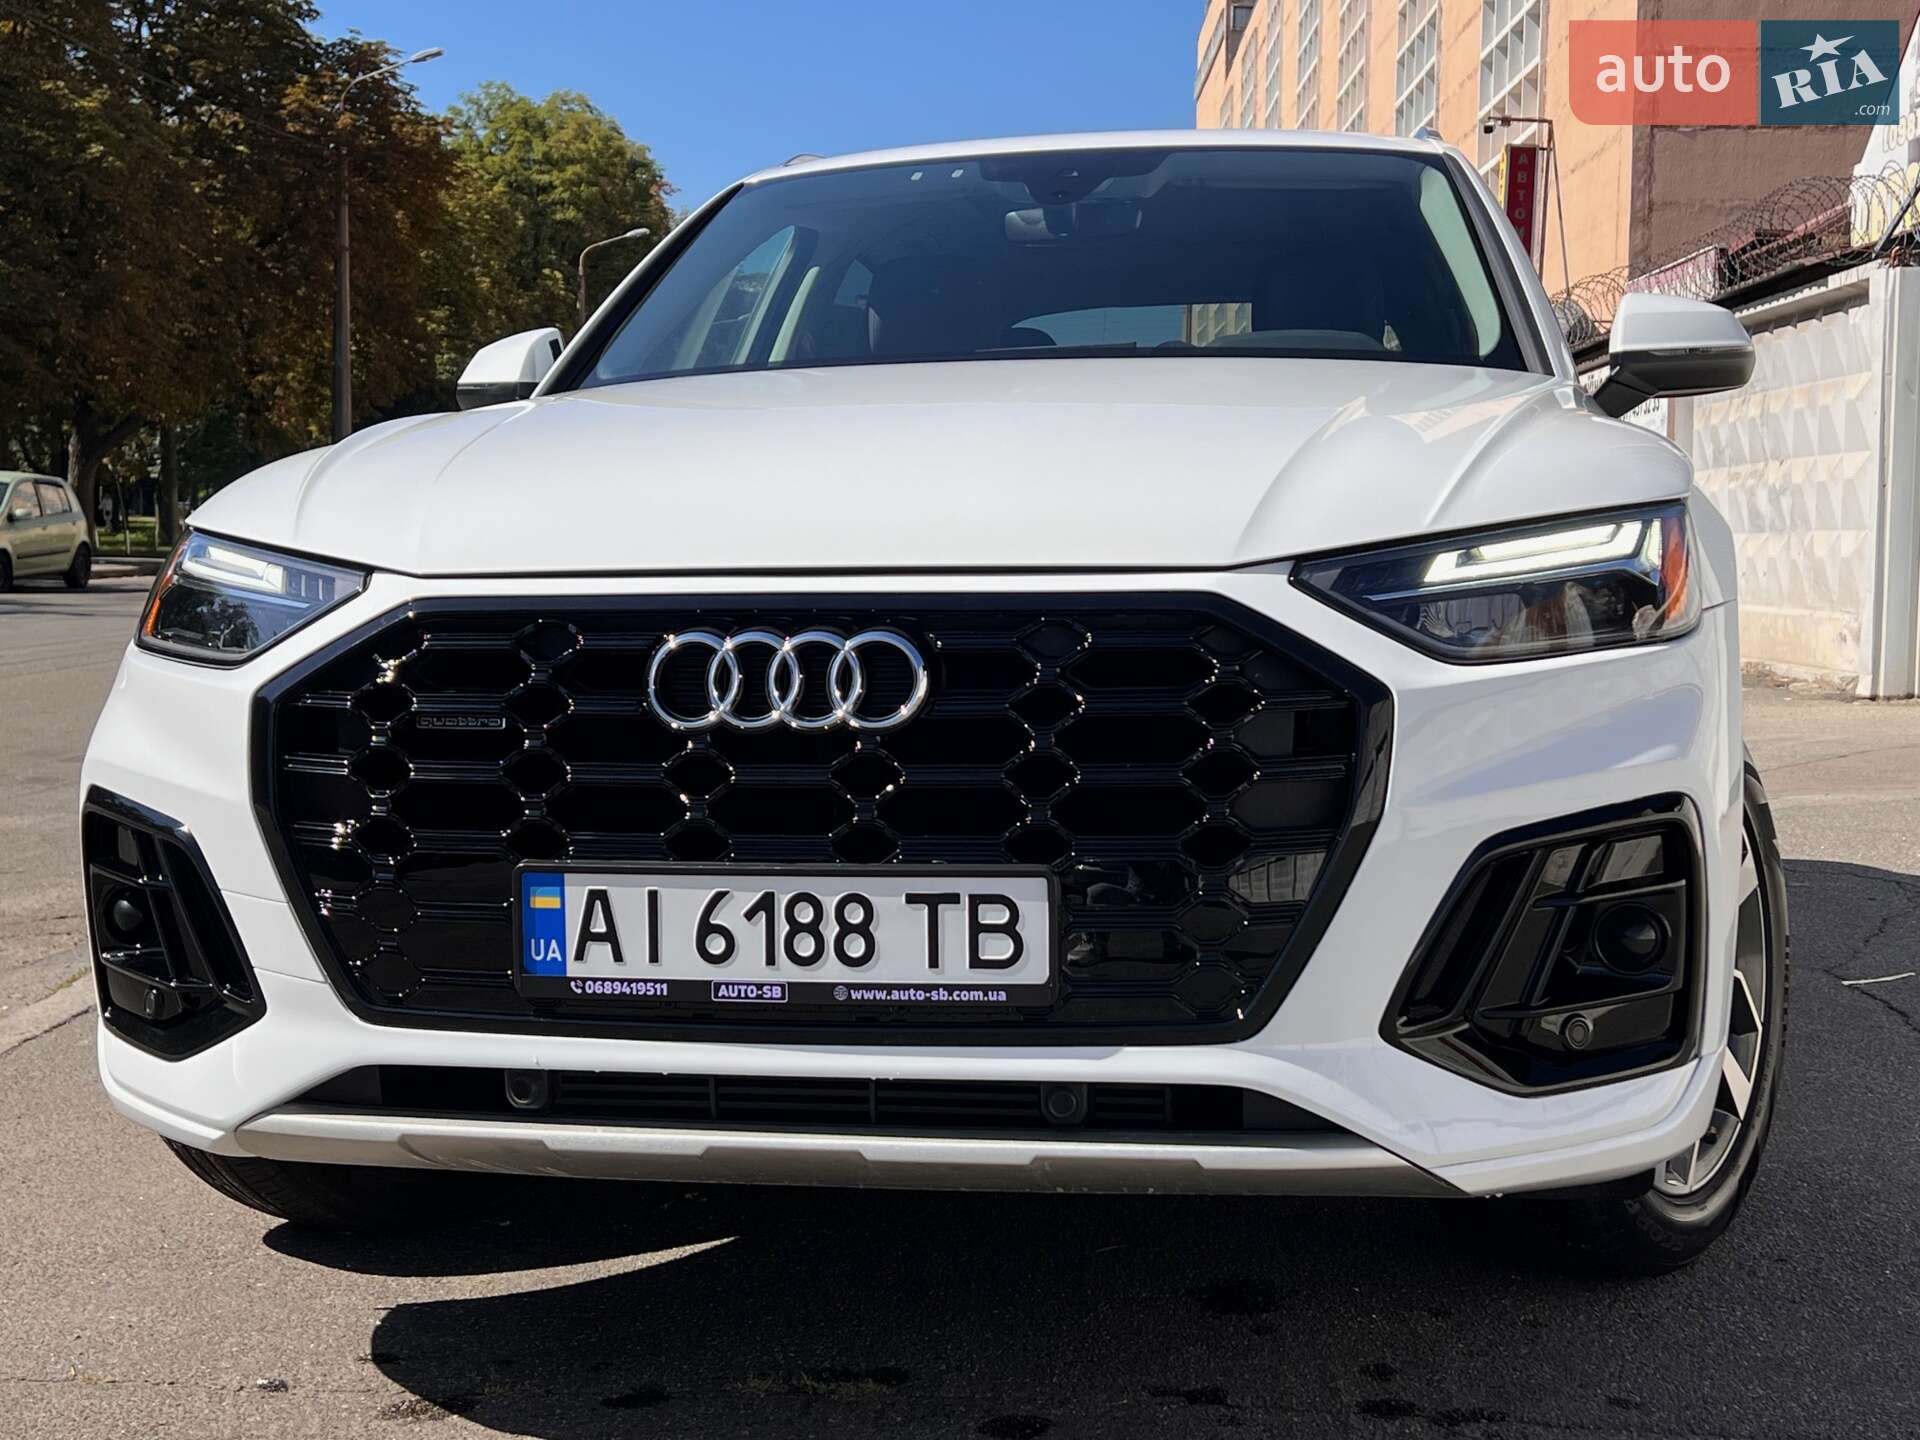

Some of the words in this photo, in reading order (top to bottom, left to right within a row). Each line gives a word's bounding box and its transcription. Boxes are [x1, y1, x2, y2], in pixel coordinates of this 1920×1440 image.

[573, 888, 660, 964] AI
[695, 890, 876, 968] 6188
[905, 892, 1025, 970] TB
[530, 939, 562, 962] UA
[584, 979, 668, 996] 0689419511
[718, 984, 783, 999] AUTO-SB
[850, 986, 1007, 1002] www.auto-sb.com.ua
